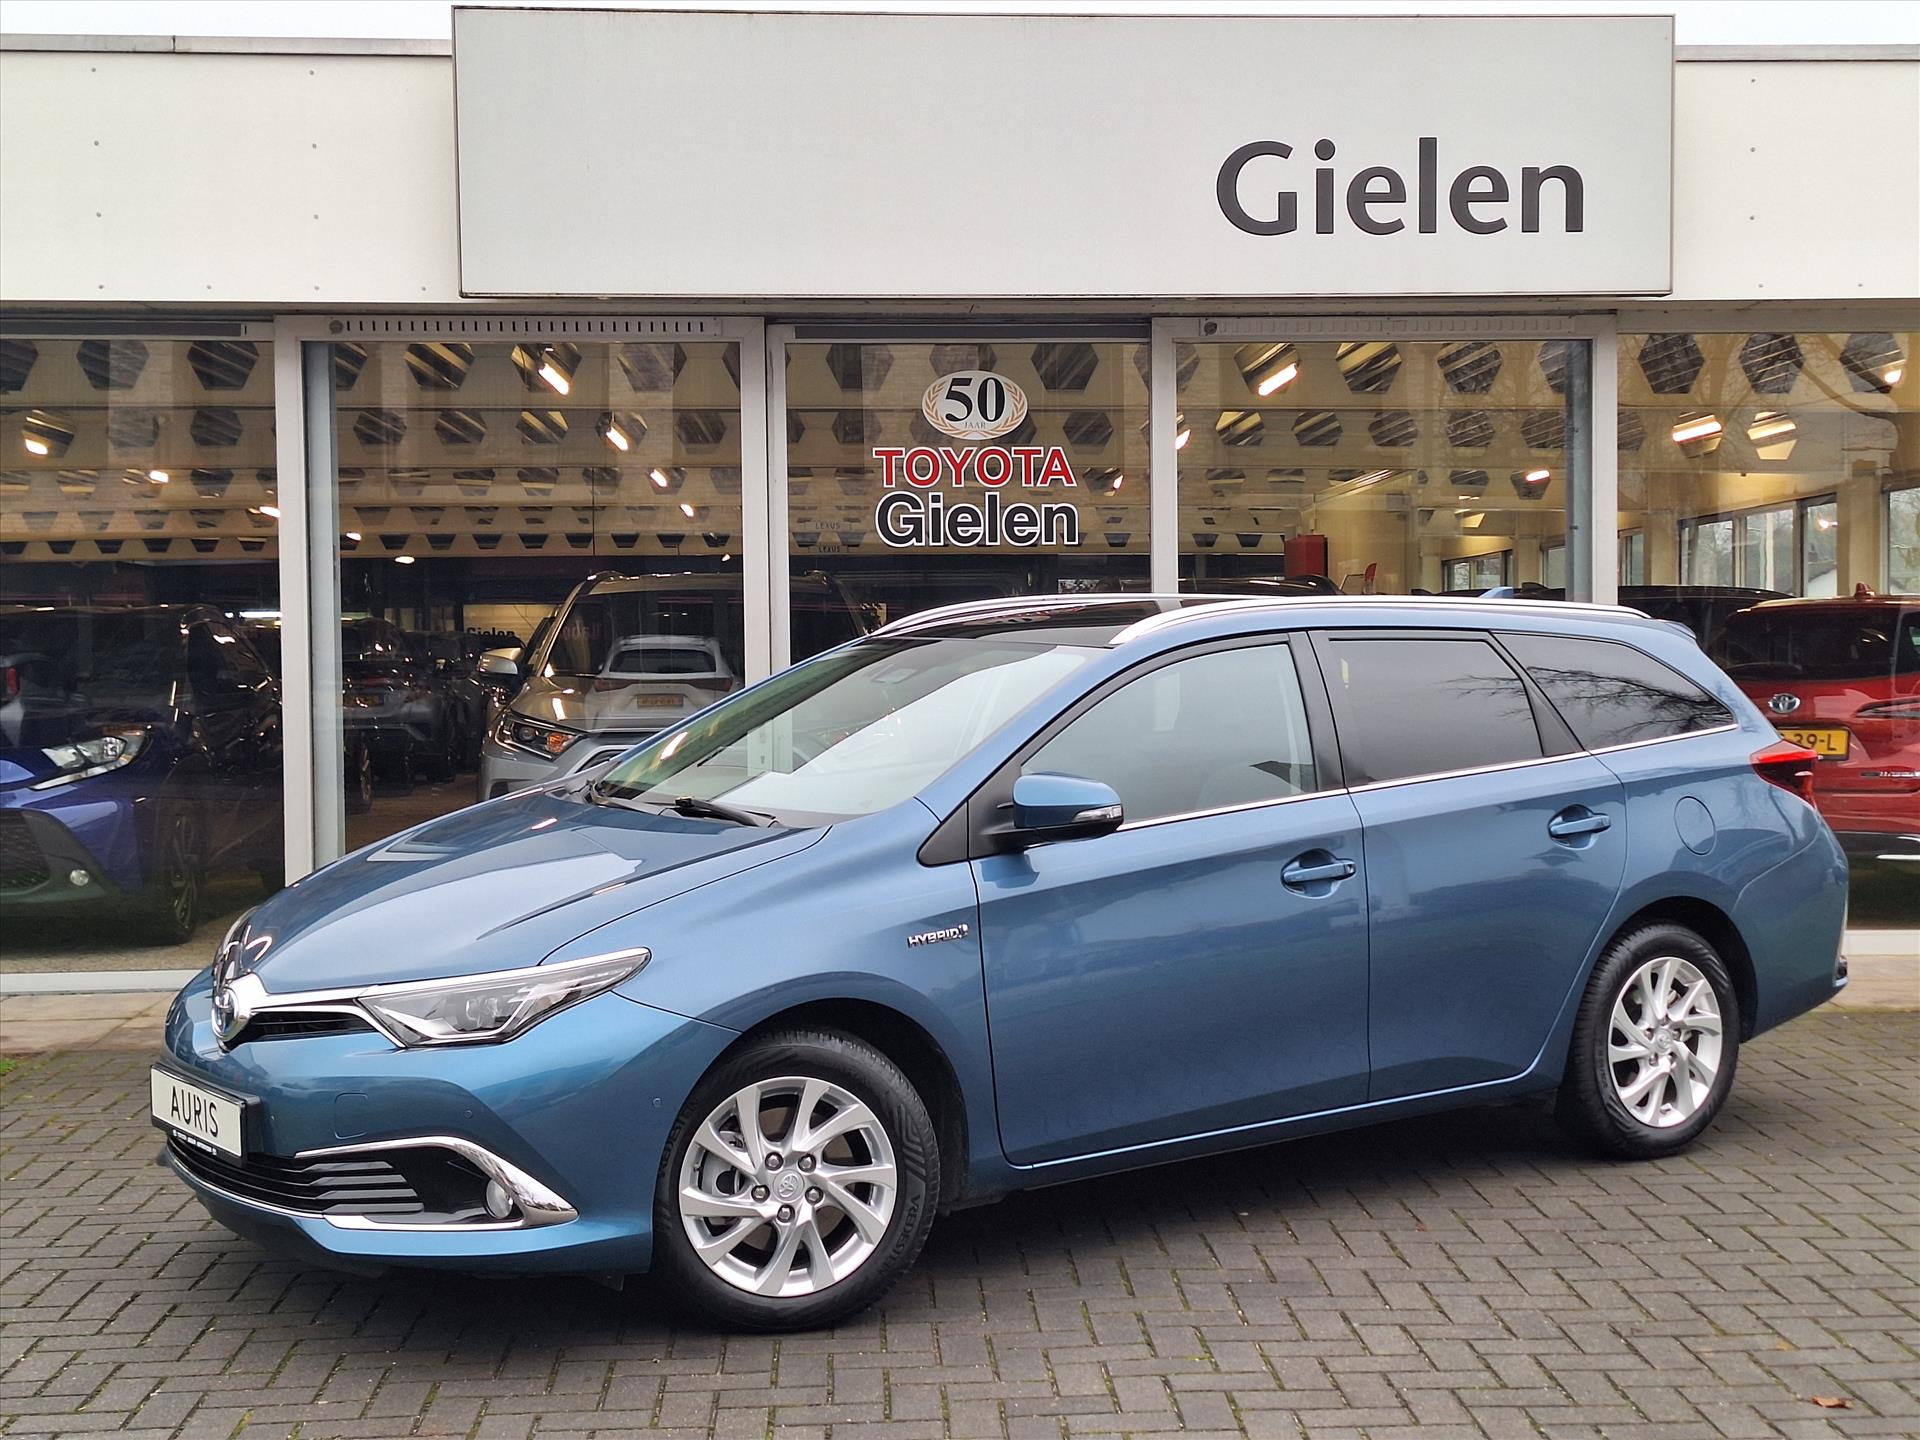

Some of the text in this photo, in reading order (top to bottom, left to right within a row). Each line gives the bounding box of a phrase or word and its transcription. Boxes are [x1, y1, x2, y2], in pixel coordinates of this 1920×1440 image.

[1216, 137, 1584, 236] Gielen
[945, 377, 1006, 422] 50
[964, 421, 987, 429] JAAR
[873, 446, 1077, 488] TOYOTA
[876, 491, 1079, 547] Gielen
[907, 928, 960, 948] HYBRID
[171, 1086, 219, 1138] AURIS
